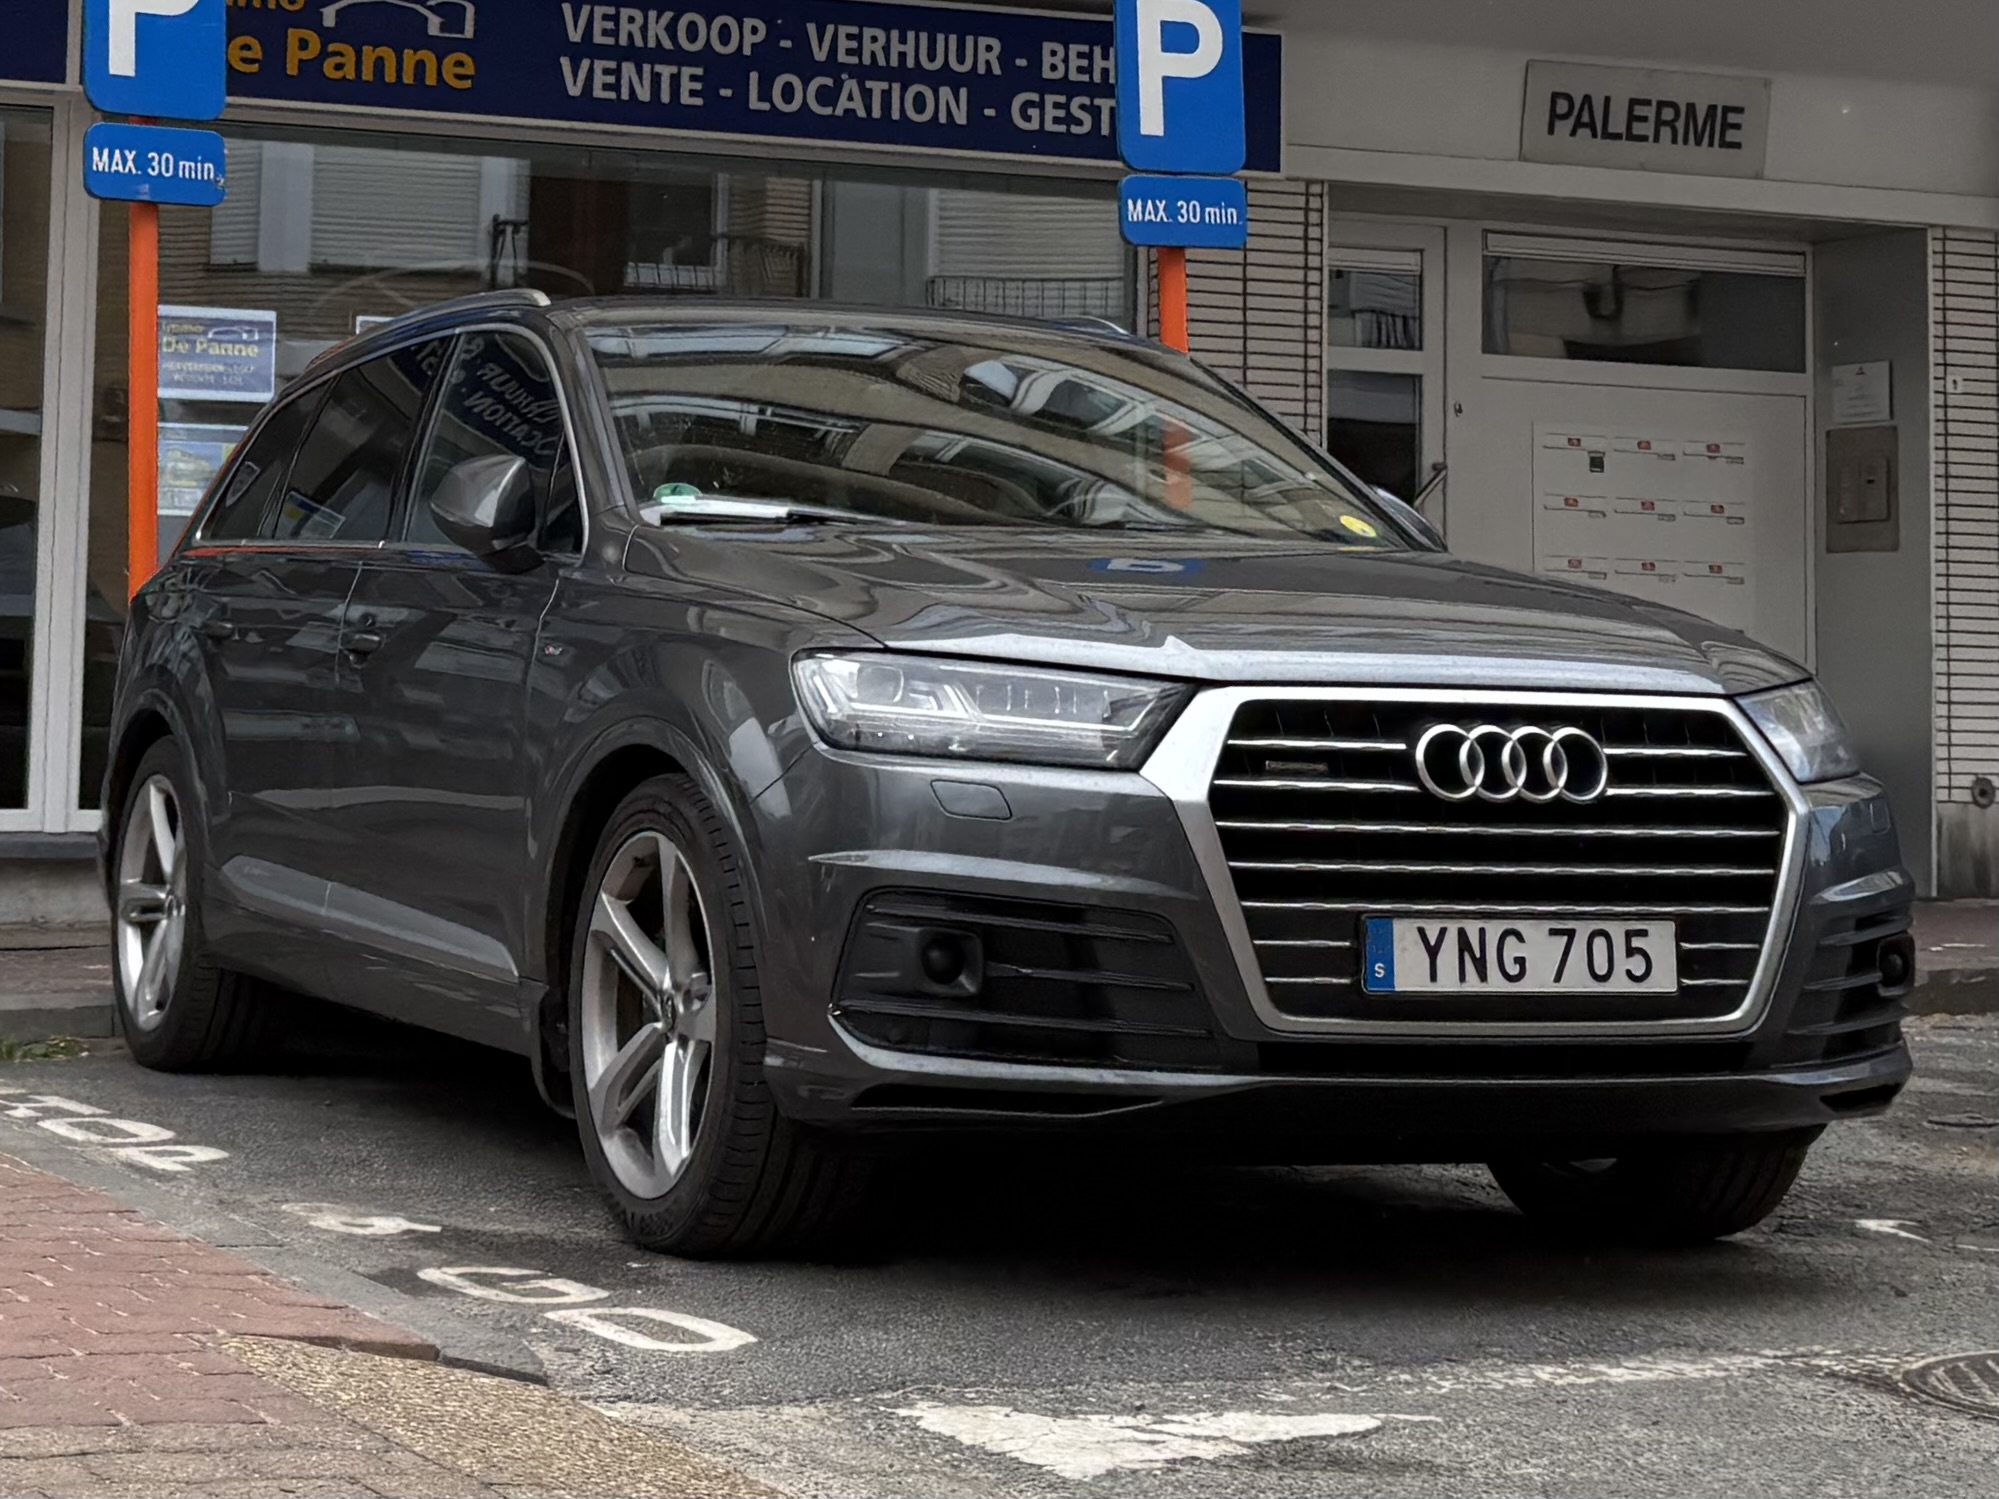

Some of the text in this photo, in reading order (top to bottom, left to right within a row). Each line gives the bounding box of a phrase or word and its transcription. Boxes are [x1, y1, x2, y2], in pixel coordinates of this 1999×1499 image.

[286, 28, 475, 89] Panne
[561, 2, 767, 56] VERKOOP
[805, 22, 1002, 75] VERHUUR
[559, 56, 705, 106] VENTE
[748, 71, 968, 125] LOCATION
[1011, 92, 1117, 136] GEST
[1135, 0, 1223, 137] P
[1547, 91, 1745, 150] PALERME
[92, 147, 142, 175] MAX.
[147, 153, 174, 177] 30
[1127, 199, 1243, 225] MAX. 30 min.
[195, 338, 259, 357] Panne
[1374, 963, 1386, 977] S
[1416, 926, 1653, 984] YNG 705
